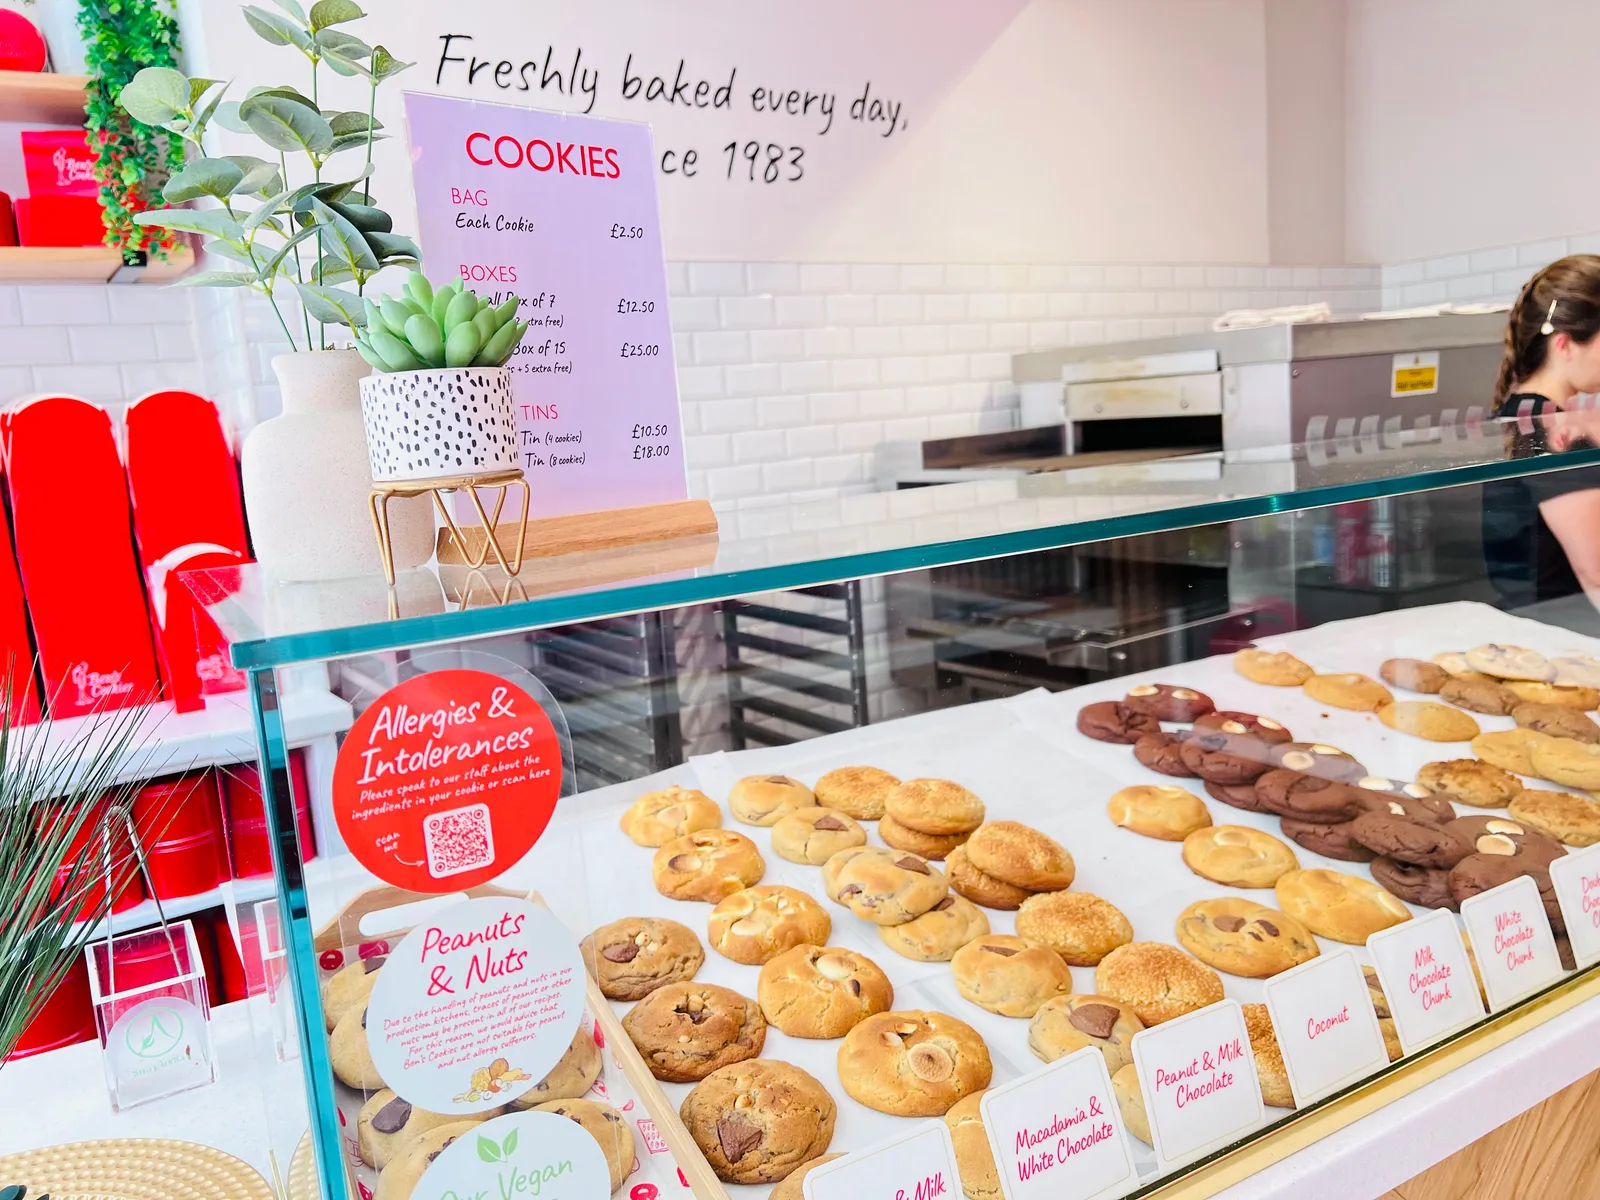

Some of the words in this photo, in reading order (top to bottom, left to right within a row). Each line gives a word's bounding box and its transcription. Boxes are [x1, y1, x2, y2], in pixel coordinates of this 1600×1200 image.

[436, 34, 601, 113] Freshly
[623, 54, 736, 110] baked
[752, 86, 838, 136] every
[849, 81, 909, 138] day,
[466, 132, 620, 178] COOKIES
[724, 141, 805, 184] 1983
[452, 188, 487, 206] BAG
[455, 213, 490, 228] Each
[496, 215, 534, 232] Cookie
[610, 224, 643, 238] £2.50
[460, 265, 517, 282] BOXES
[533, 292, 545, 308] of
[550, 294, 555, 307] 7
[617, 299, 654, 313] £12.50
[546, 315, 563, 328] free)
[538, 340, 551, 356] of
[555, 342, 565, 354] 15
[621, 343, 659, 357] £25.00
[525, 364, 529, 373] 5
[532, 364, 552, 372] extra
[554, 361, 572, 374] free)
[520, 404, 558, 420] TINS
[521, 430, 540, 446] Tin
[545, 432, 553, 446] (4
[555, 430, 582, 444] cookies)
[632, 424, 668, 439] £10.50
[525, 453, 545, 468] Tin
[550, 454, 557, 467] (8
[559, 452, 586, 465] cookies)
[633, 445, 669, 460] £18.00
[369, 700, 480, 745] Allergies
[488, 687, 516, 718] &
[356, 727, 533, 784] Intolerances
[352, 798, 412, 820] ingredients
[416, 796, 425, 805] in
[429, 792, 452, 806] your
[455, 782, 485, 796] cookie
[488, 781, 499, 789] or
[502, 775, 526, 786] scan
[529, 769, 550, 779] here
[360, 789, 393, 803] Please
[397, 779, 426, 796] speak
[430, 776, 440, 788] to
[444, 774, 460, 783] our
[464, 764, 490, 780] staff
[491, 760, 520, 774] about
[524, 755, 540, 767] the
[376, 832, 400, 847] scan
[384, 842, 398, 853] me
[1495, 910, 1521, 932] White
[421, 912, 524, 963] Peanuts
[1495, 925, 1534, 954] Chocolate
[427, 966, 455, 996] &
[466, 948, 527, 989] Nuts
[1415, 946, 1435, 970] Milk
[1507, 943, 1534, 971] Chunk
[1410, 964, 1451, 993] Chocolate
[384, 1019, 400, 1031] Due
[415, 1010, 428, 1019] the
[431, 1000, 466, 1014] handling
[469, 993, 478, 1003] of
[479, 986, 510, 1001] peanuts
[513, 978, 528, 989] and
[530, 973, 548, 984] nuts
[386, 1023, 431, 1043] production
[473, 1000, 499, 1013] traces
[502, 994, 510, 1004] of
[512, 988, 538, 1004] peanut
[552, 978, 572, 989] other
[1422, 982, 1452, 1010] Chunk
[401, 1036, 420, 1047] nuts
[422, 1030, 439, 1040] may
[442, 1026, 451, 1034] be
[453, 1016, 484, 1033] present
[497, 1007, 507, 1017] all
[509, 1002, 518, 1013] of
[519, 1002, 532, 1010] our
[409, 1046, 423, 1057] For
[426, 1040, 442, 1051] this
[478, 1026, 488, 1034] we
[490, 1016, 512, 1030] would
[514, 1010, 538, 1022] advise
[540, 1003, 558, 1014] that
[428, 1047, 458, 1062] Cookies
[460, 1042, 474, 1050] are
[477, 1035, 490, 1044] not
[493, 1024, 523, 1040] suitable
[525, 1020, 537, 1030] for
[539, 1010, 566, 1028] peanut
[1307, 1005, 1350, 1040] Coconut
[438, 1057, 454, 1070] and
[456, 1053, 470, 1063] nut
[473, 1045, 498, 1058] allergy
[1156, 1058, 1199, 1092] Peanut
[1202, 1051, 1215, 1071] &
[1218, 1038, 1243, 1066] Milk
[1176, 1071, 1233, 1108] Chocolate
[1016, 1107, 1087, 1154] Macadamia
[1090, 1096, 1104, 1117] &
[1018, 1152, 1053, 1181] White
[1057, 1122, 1113, 1164] Chocolate
[498, 1160, 573, 1200] Vegan
[915, 1172, 946, 1200] Milk
